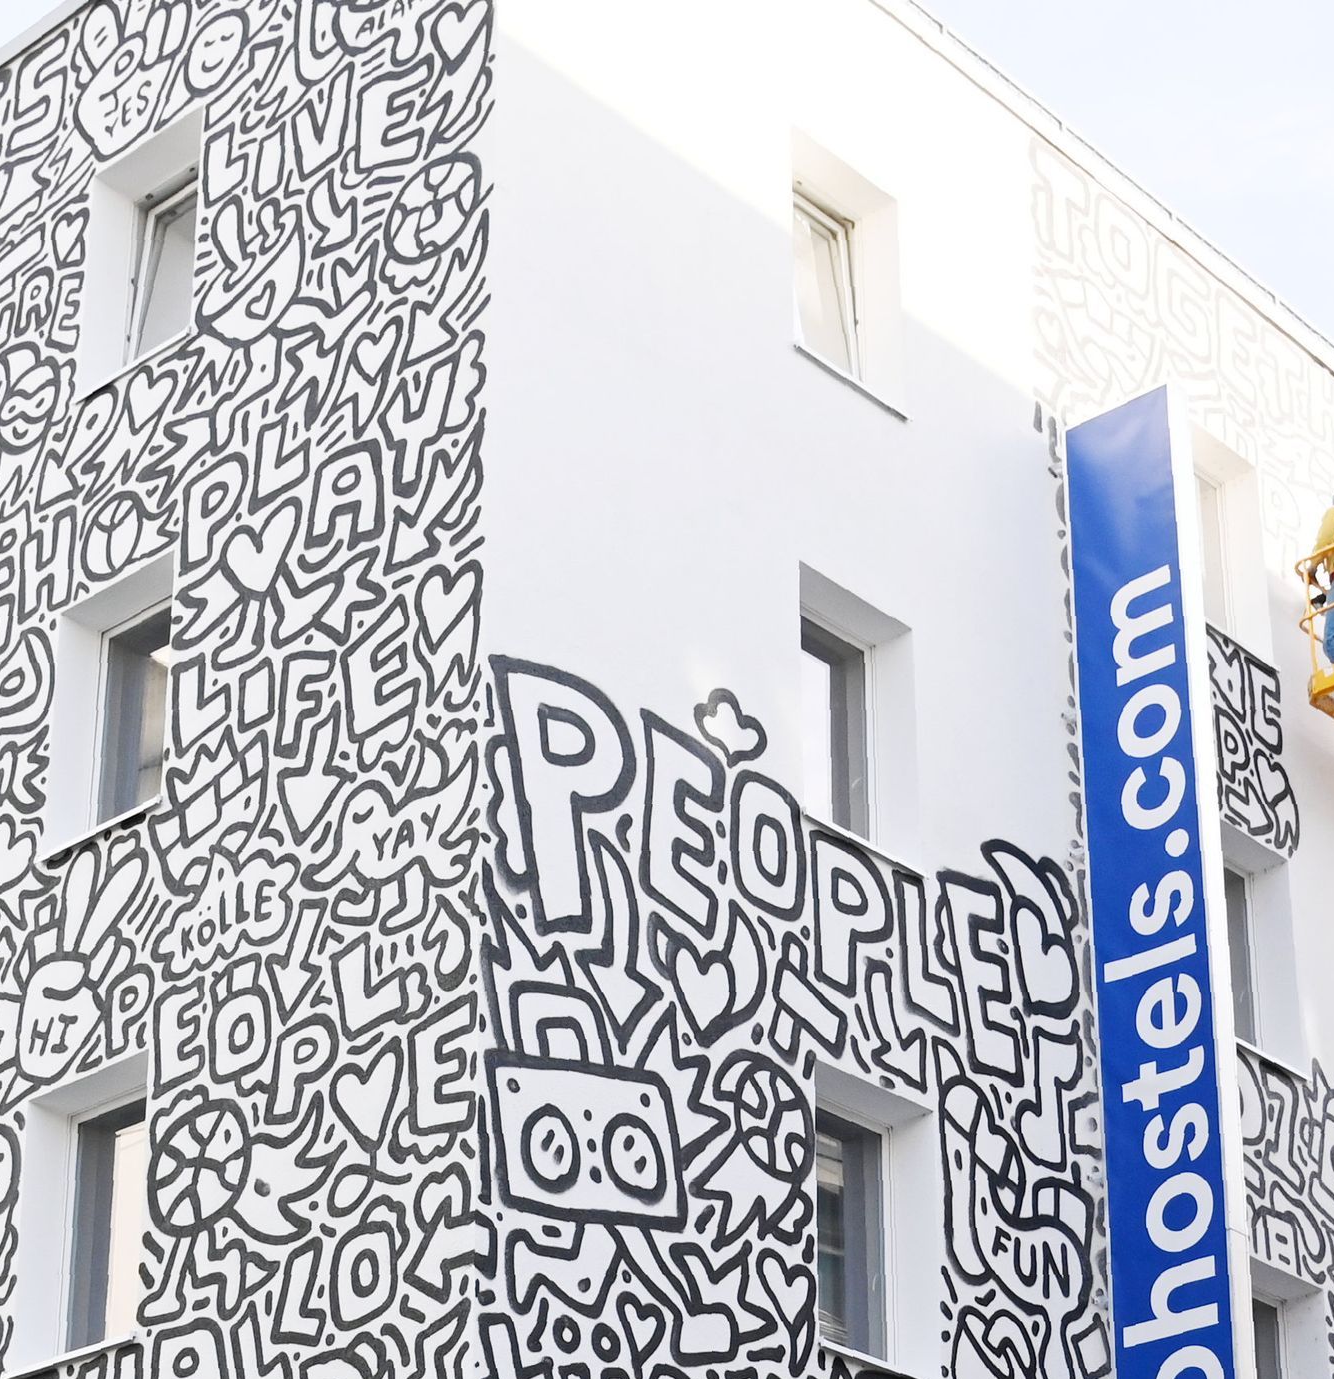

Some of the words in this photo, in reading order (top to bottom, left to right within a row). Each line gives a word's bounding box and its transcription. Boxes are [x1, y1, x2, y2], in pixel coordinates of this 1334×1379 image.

[106, 76, 152, 145] YES
[203, 54, 434, 208] LIVE
[180, 358, 473, 576] PLAY
[171, 603, 423, 758] LIFE
[374, 802, 438, 869] YAY
[488, 653, 1025, 1087] PEOPLE
[181, 865, 272, 960] KÖLLE
[31, 1006, 74, 1066] HI
[104, 934, 477, 1136] PEOPLE
[992, 1226, 1070, 1300] FUN
